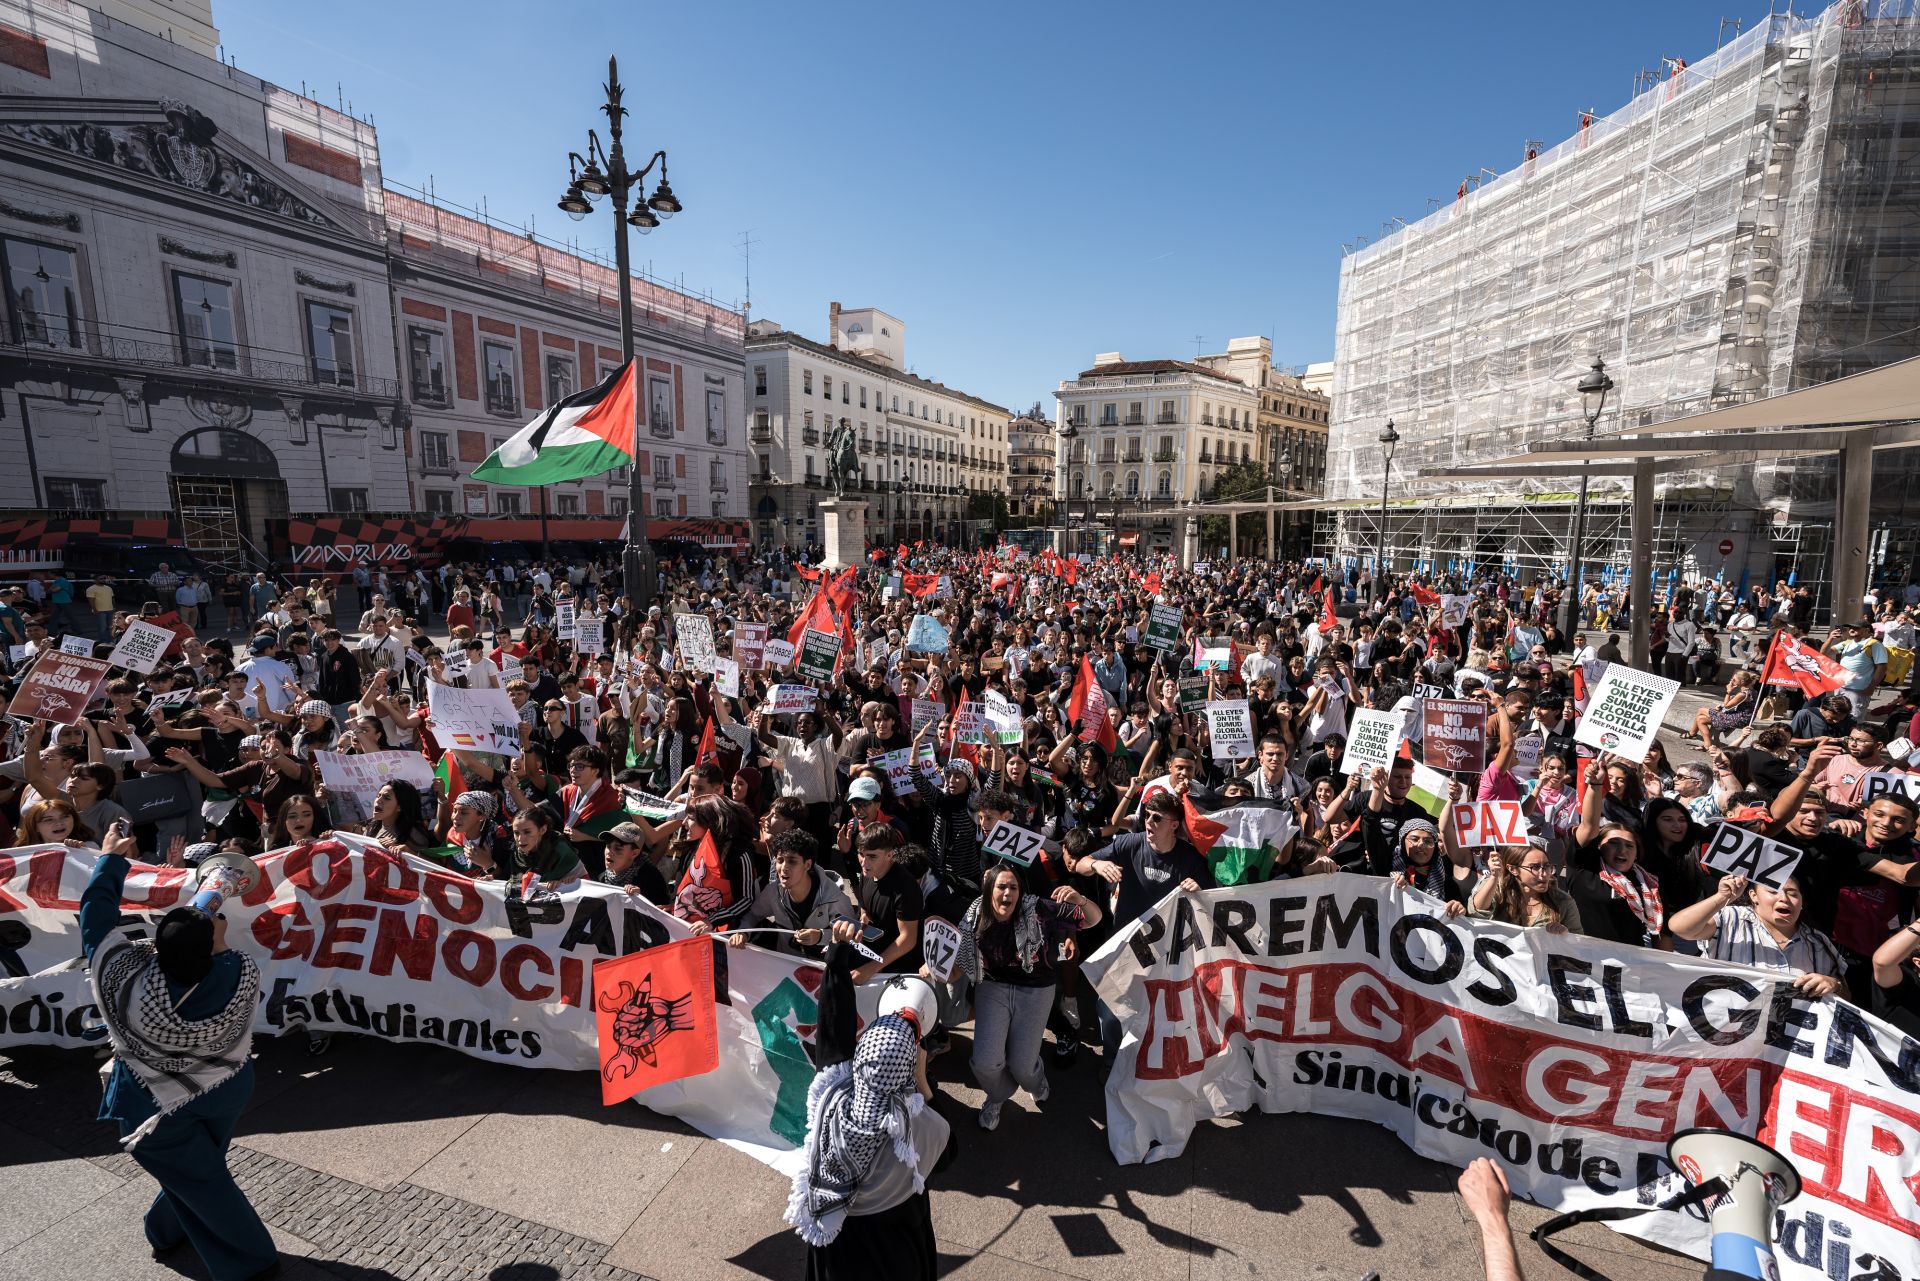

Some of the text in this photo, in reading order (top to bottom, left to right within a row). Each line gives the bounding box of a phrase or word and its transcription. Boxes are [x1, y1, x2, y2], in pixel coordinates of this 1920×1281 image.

[131, 637, 158, 649] SUMUD
[133, 628, 167, 642] ALL EYES
[134, 633, 161, 645] ON THE
[746, 631, 756, 640] NO
[121, 645, 156, 660] FLOTILLA
[126, 641, 156, 655] GLOBAL
[46, 652, 107, 671] EL SIONISMO
[55, 664, 81, 678] NO
[30, 671, 91, 695] PASARÁ
[1412, 683, 1442, 698] PAZ
[1608, 678, 1664, 702] ALL EYES
[1605, 695, 1650, 715] SUMUD
[1610, 687, 1655, 708] ON THE
[1427, 701, 1483, 714] EL SIONISMO
[1599, 702, 1647, 725] GLOBAL
[1357, 719, 1395, 731] ALL EYES
[1443, 712, 1463, 727] NO
[1592, 708, 1647, 735] FLOTILLA
[1357, 732, 1388, 744] SUMUD
[1359, 726, 1390, 738] ON THE
[1427, 724, 1480, 742] PASARÁ
[1588, 718, 1644, 741] FREE PALESTINE
[1350, 745, 1388, 759] FLOTILLA
[1354, 739, 1388, 752] GLOBAL
[1359, 755, 1387, 765] PALESTINE
[1454, 802, 1527, 846] PAZ
[988, 825, 1040, 862] PAZ
[1704, 826, 1800, 890] PAZ
[925, 922, 957, 944] JUSTA
[251, 902, 612, 1013] GENOCI
[1129, 893, 1517, 1007] PAREMOS
[1547, 953, 1653, 1039] EL
[1146, 966, 1479, 1091] HUELGA
[1536, 1137, 1622, 1196] de
